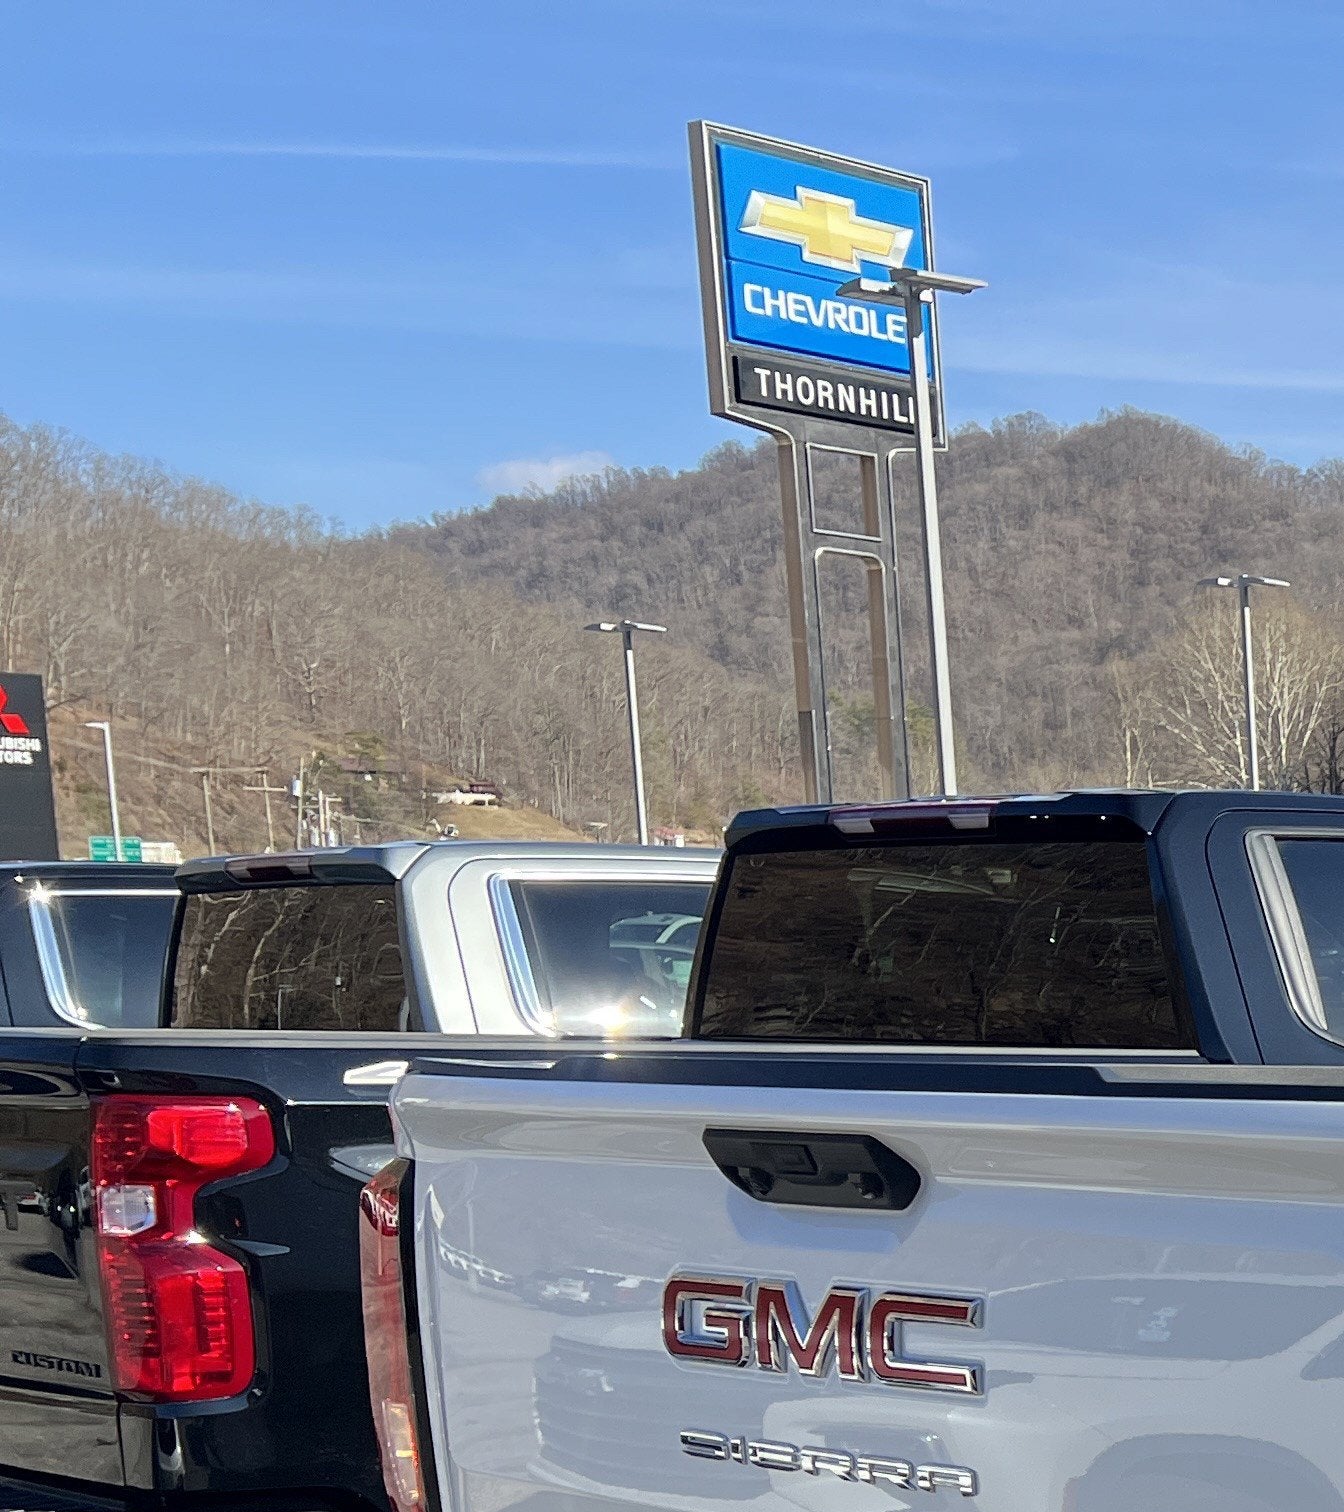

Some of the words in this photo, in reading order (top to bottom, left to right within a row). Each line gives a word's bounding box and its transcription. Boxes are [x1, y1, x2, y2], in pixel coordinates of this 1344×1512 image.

[743, 283, 907, 345] CHEVROLE
[11, 1349, 102, 1379] CUSTOM
[661, 1271, 984, 1396] GMC
[679, 1427, 980, 1498] SIERRA
